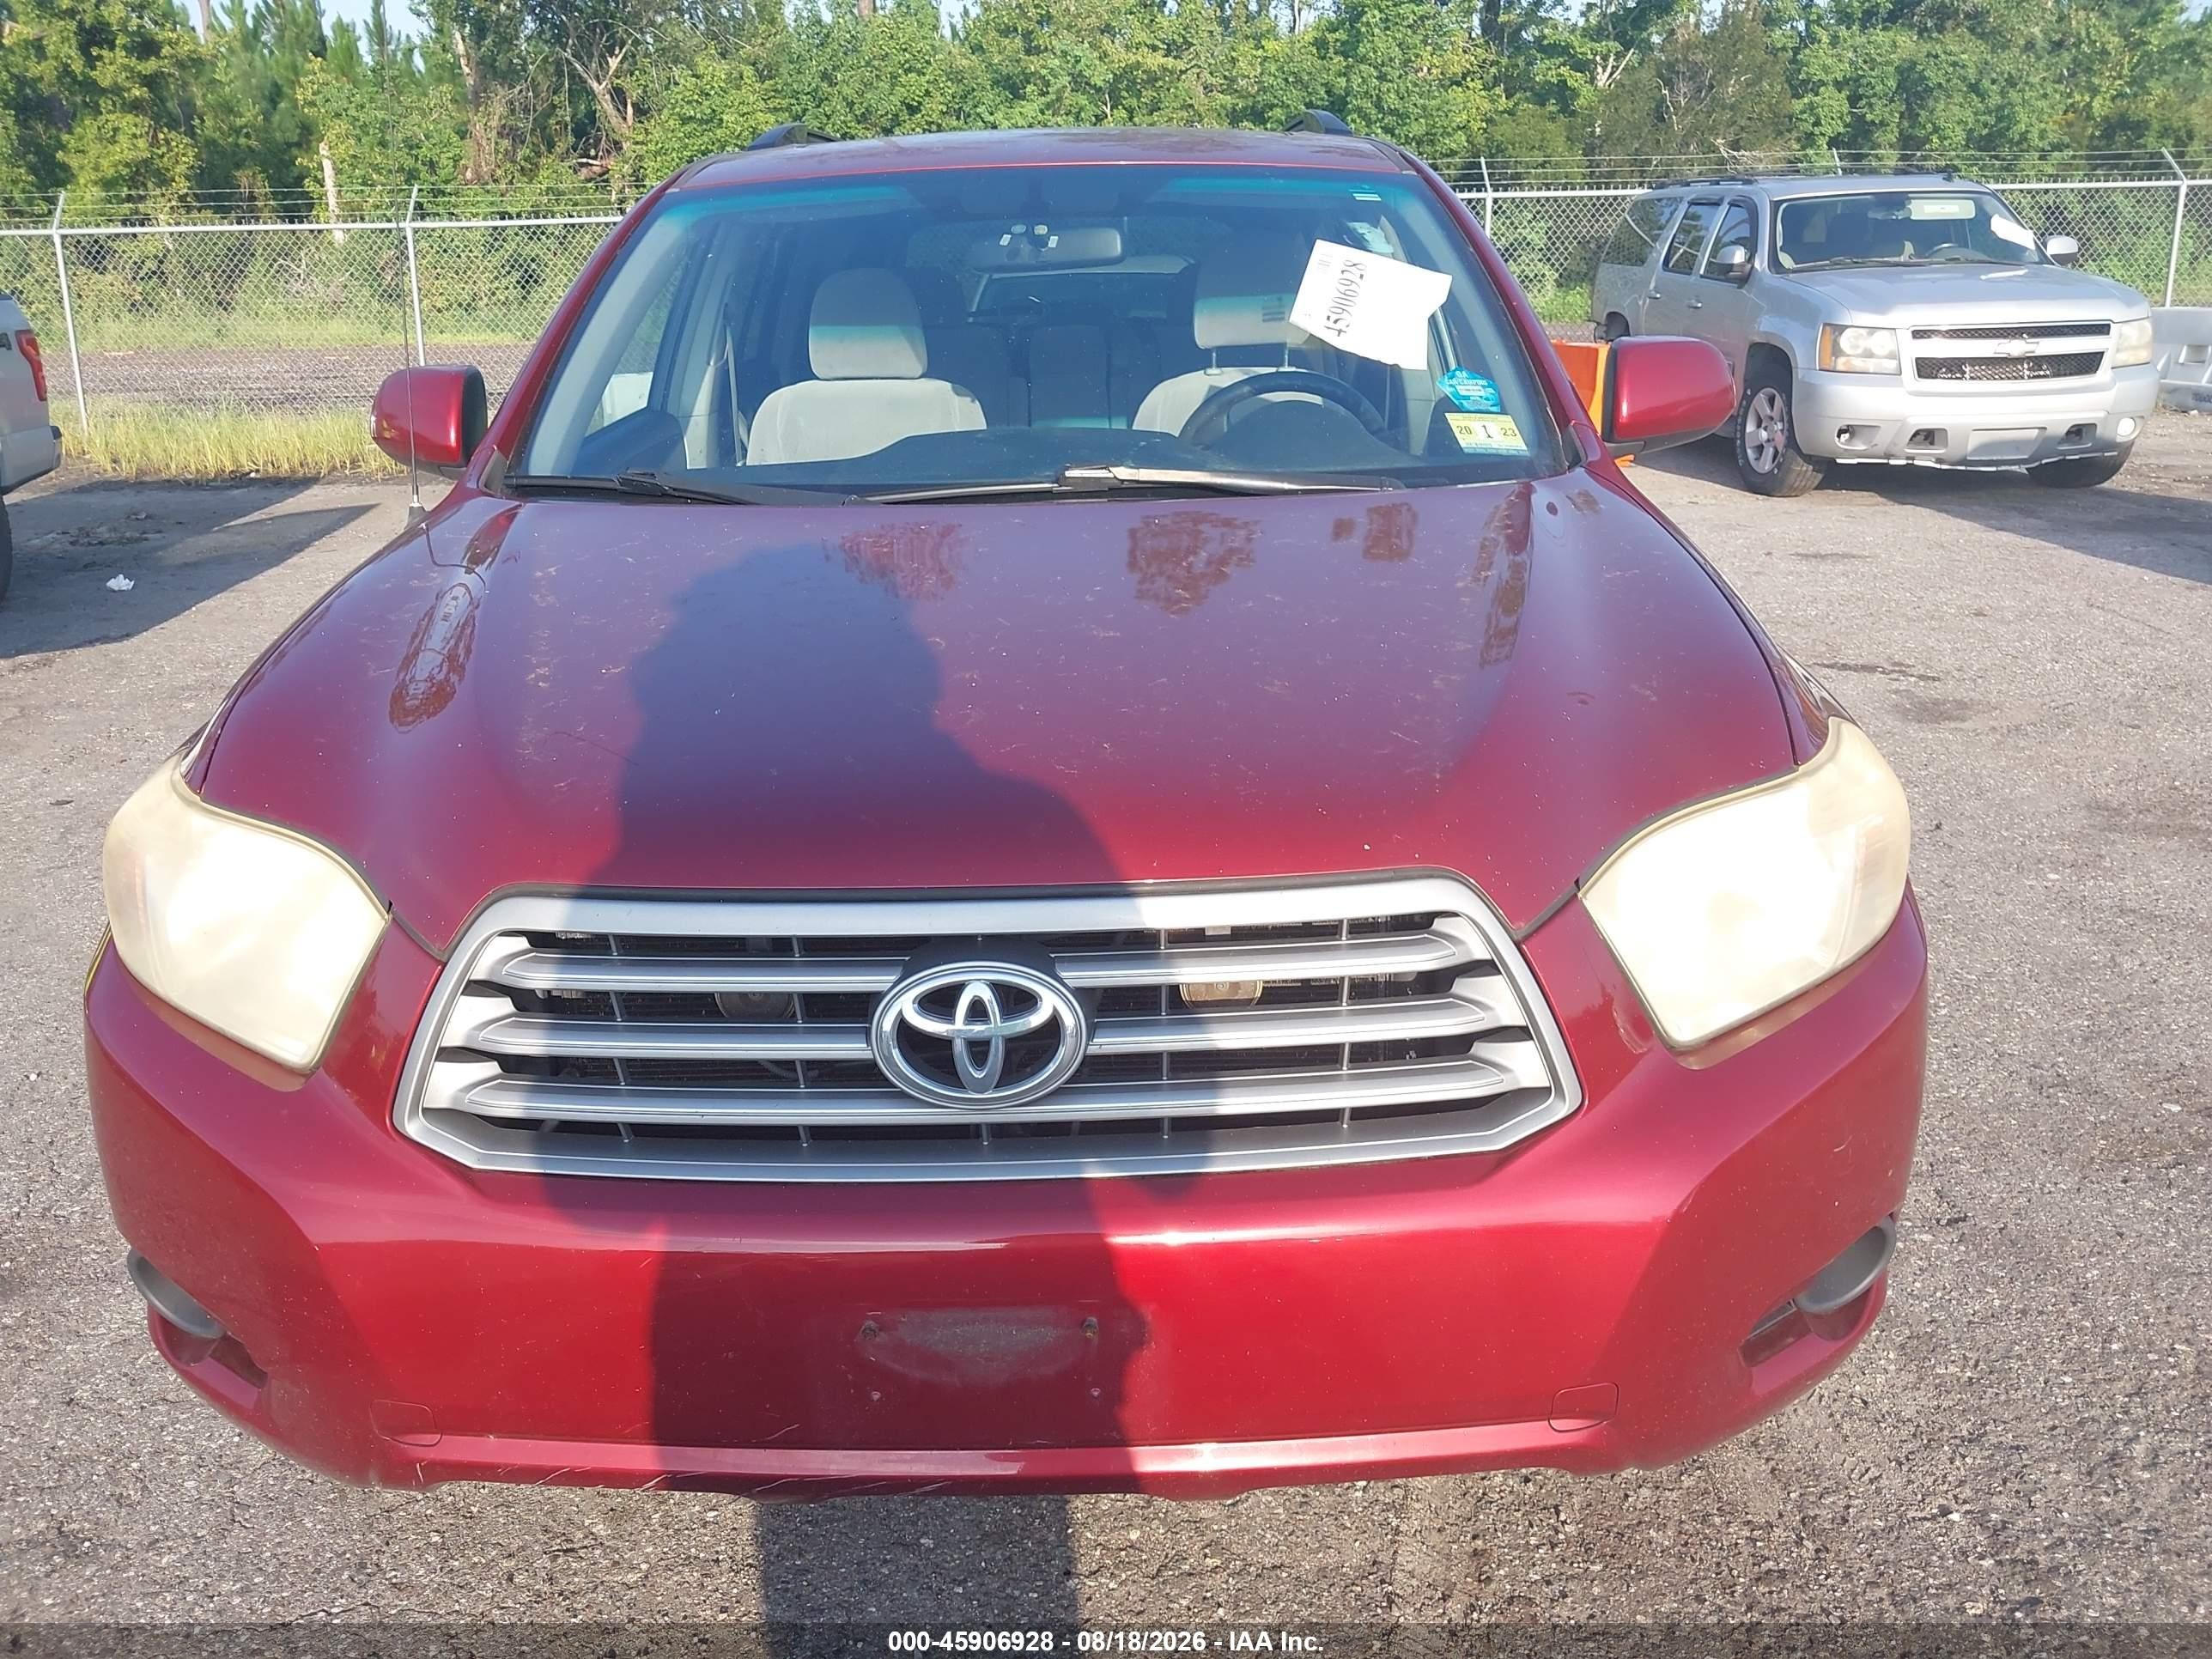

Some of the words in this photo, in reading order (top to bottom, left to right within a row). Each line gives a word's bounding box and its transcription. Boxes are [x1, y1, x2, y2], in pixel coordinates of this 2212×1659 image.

[1324, 259, 1367, 337] 45906928
[1456, 425, 1473, 435] 20
[1481, 424, 1493, 439] 1
[1500, 427, 1517, 437] 23
